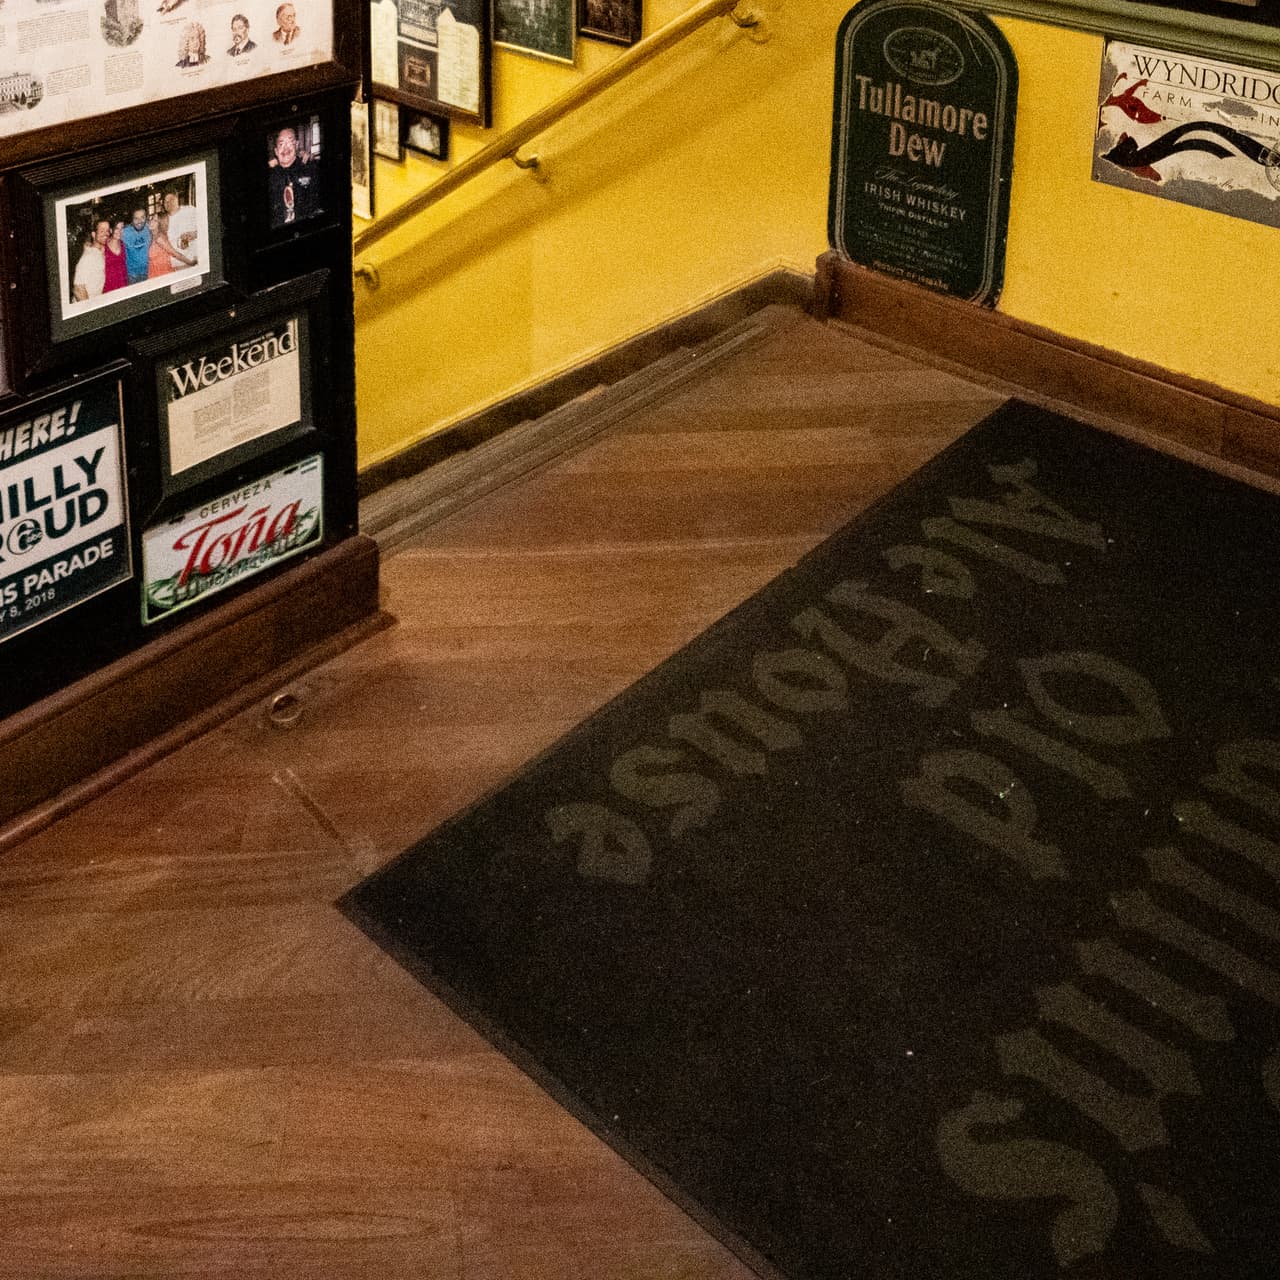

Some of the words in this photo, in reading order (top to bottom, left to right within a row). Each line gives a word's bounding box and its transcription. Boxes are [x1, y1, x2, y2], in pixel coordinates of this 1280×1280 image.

[855, 73, 988, 141] Tullamore
[1142, 87, 1193, 108] FARM
[888, 121, 947, 169] Dew
[864, 181, 901, 203] IRISH
[905, 194, 967, 222] WHISKEY
[167, 320, 298, 401] Weekend
[199, 480, 272, 519] CERVEZA
[23, 537, 115, 596] PARADE
[173, 497, 303, 588] Toña
[8, 604, 22, 619] 8,
[25, 589, 56, 611] 2018
[543, 579, 987, 886] House
[901, 650, 1172, 880] Old
